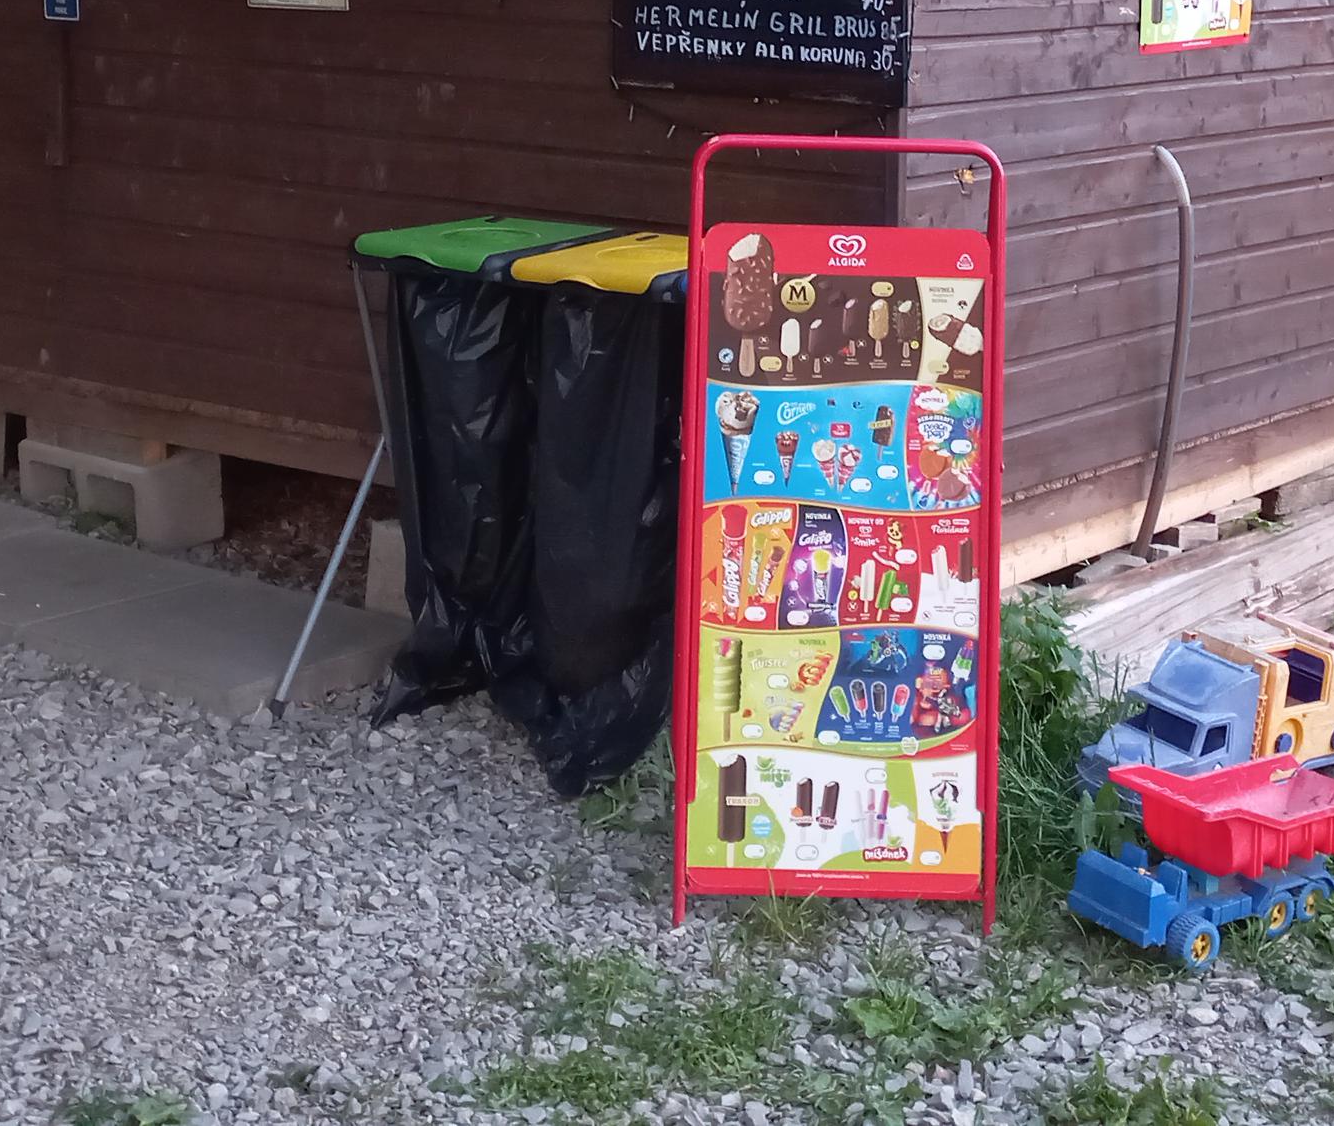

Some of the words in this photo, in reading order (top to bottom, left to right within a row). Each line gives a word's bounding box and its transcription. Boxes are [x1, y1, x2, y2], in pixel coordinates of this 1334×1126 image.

[634, 0, 760, 31] HERMELÍN
[769, 10, 828, 38] GRIL
[833, 15, 877, 38] BRUS
[799, 45, 867, 69] KORUNA
[827, 257, 867, 267] ALGIDA
[750, 508, 792, 528] Calippo
[722, 558, 740, 608] Calippo
